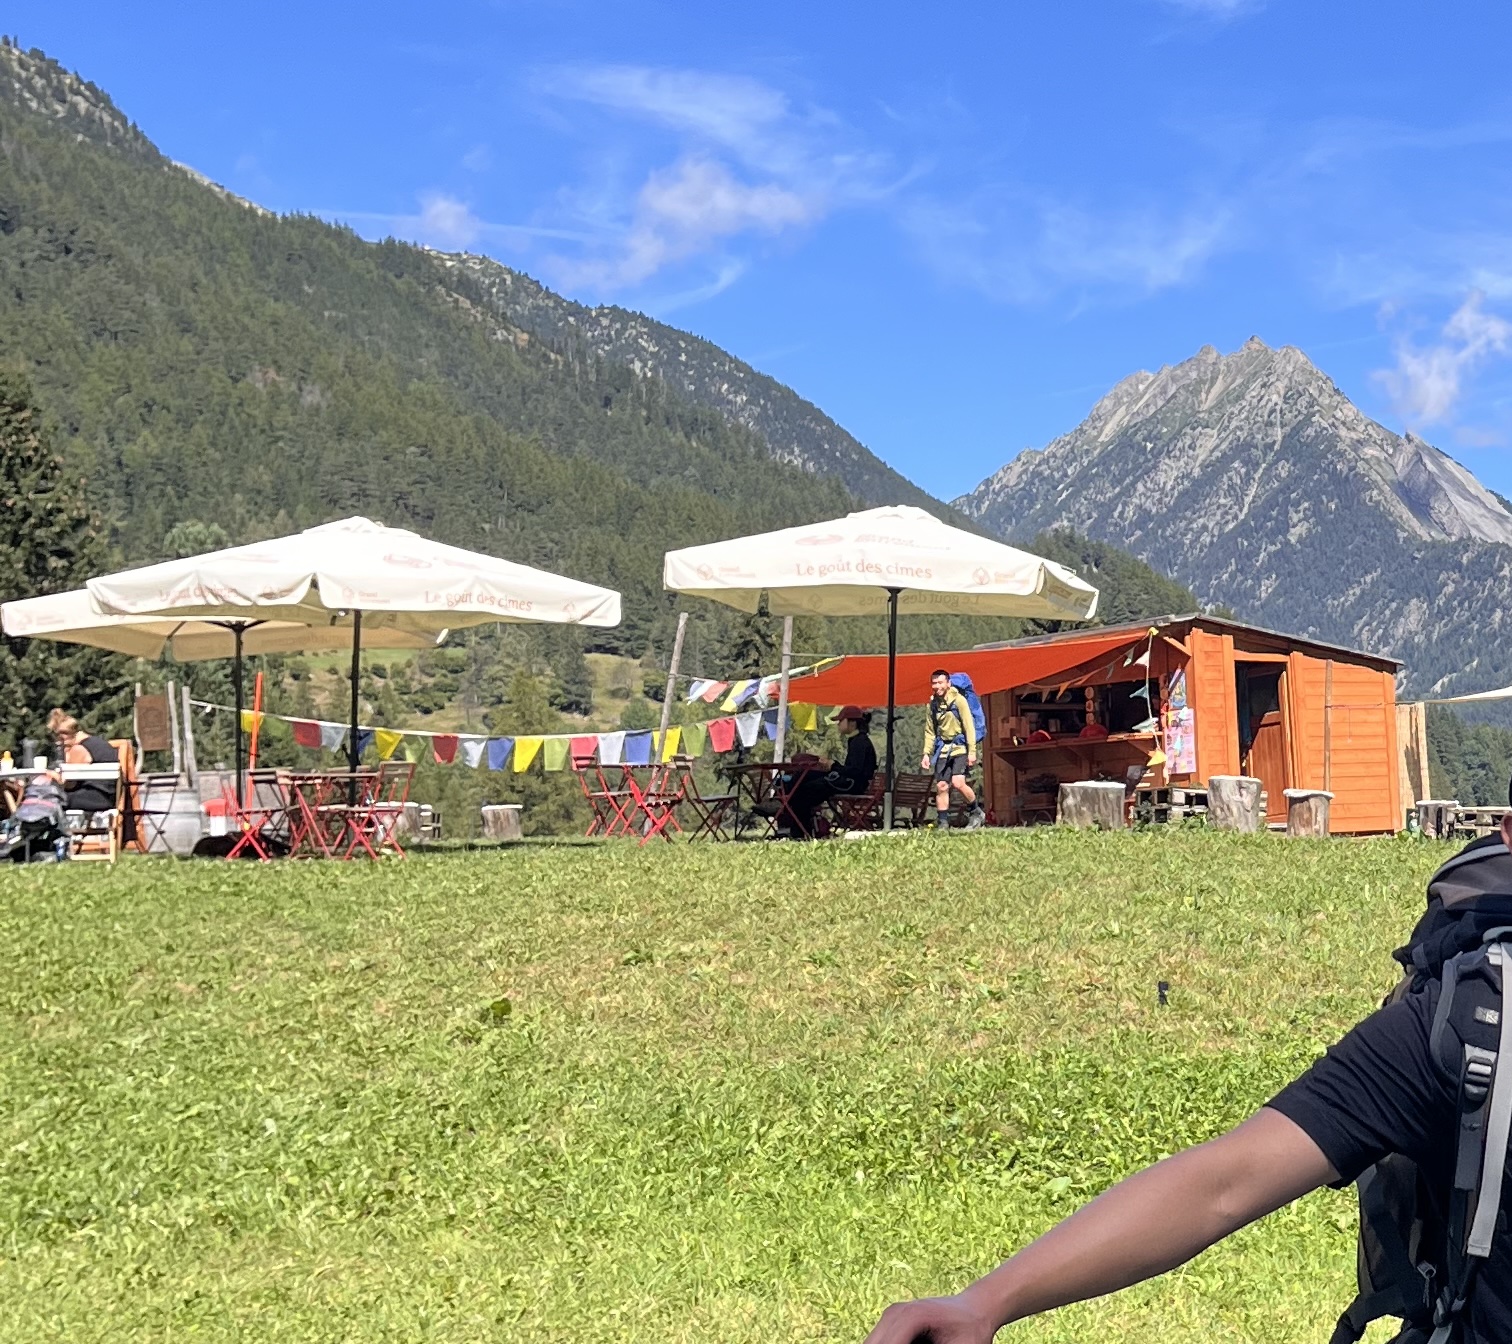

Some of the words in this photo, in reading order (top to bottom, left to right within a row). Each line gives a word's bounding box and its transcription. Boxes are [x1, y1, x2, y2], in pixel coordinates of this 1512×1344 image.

[795, 563, 815, 576] Le
[855, 558, 882, 573] des
[885, 562, 932, 578] cimes
[425, 590, 441, 603] Le
[498, 594, 533, 611] cimes
